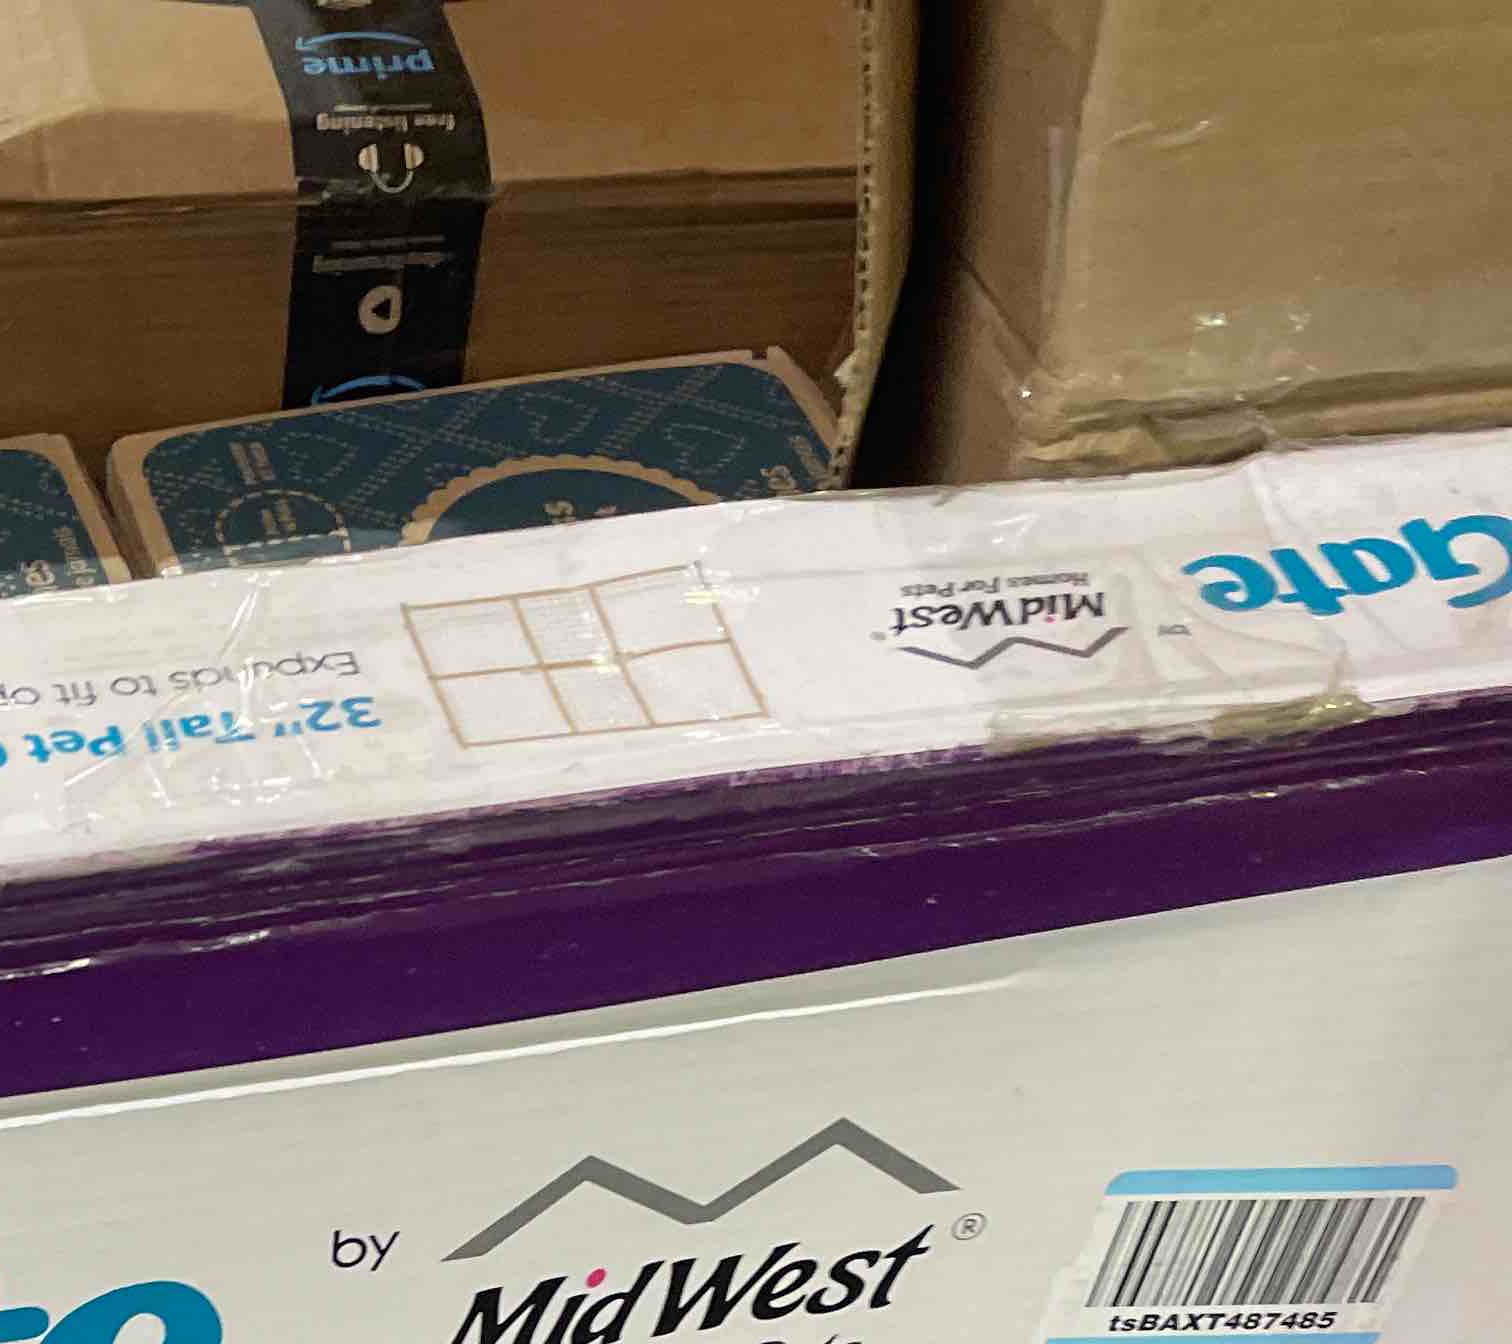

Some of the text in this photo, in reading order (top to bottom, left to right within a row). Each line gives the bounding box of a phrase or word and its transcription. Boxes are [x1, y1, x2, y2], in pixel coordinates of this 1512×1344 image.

[302, 49, 436, 80] prime
[1181, 515, 1512, 616] Gate
[900, 572, 1089, 598] Homes For Pets
[890, 592, 1104, 636] MidWest
[110, 675, 157, 696] to
[273, 696, 383, 738] 32"
[22, 725, 126, 763] Pet
[332, 1230, 400, 1272] by
[1108, 1311, 1338, 1333] tsBAXT487485
